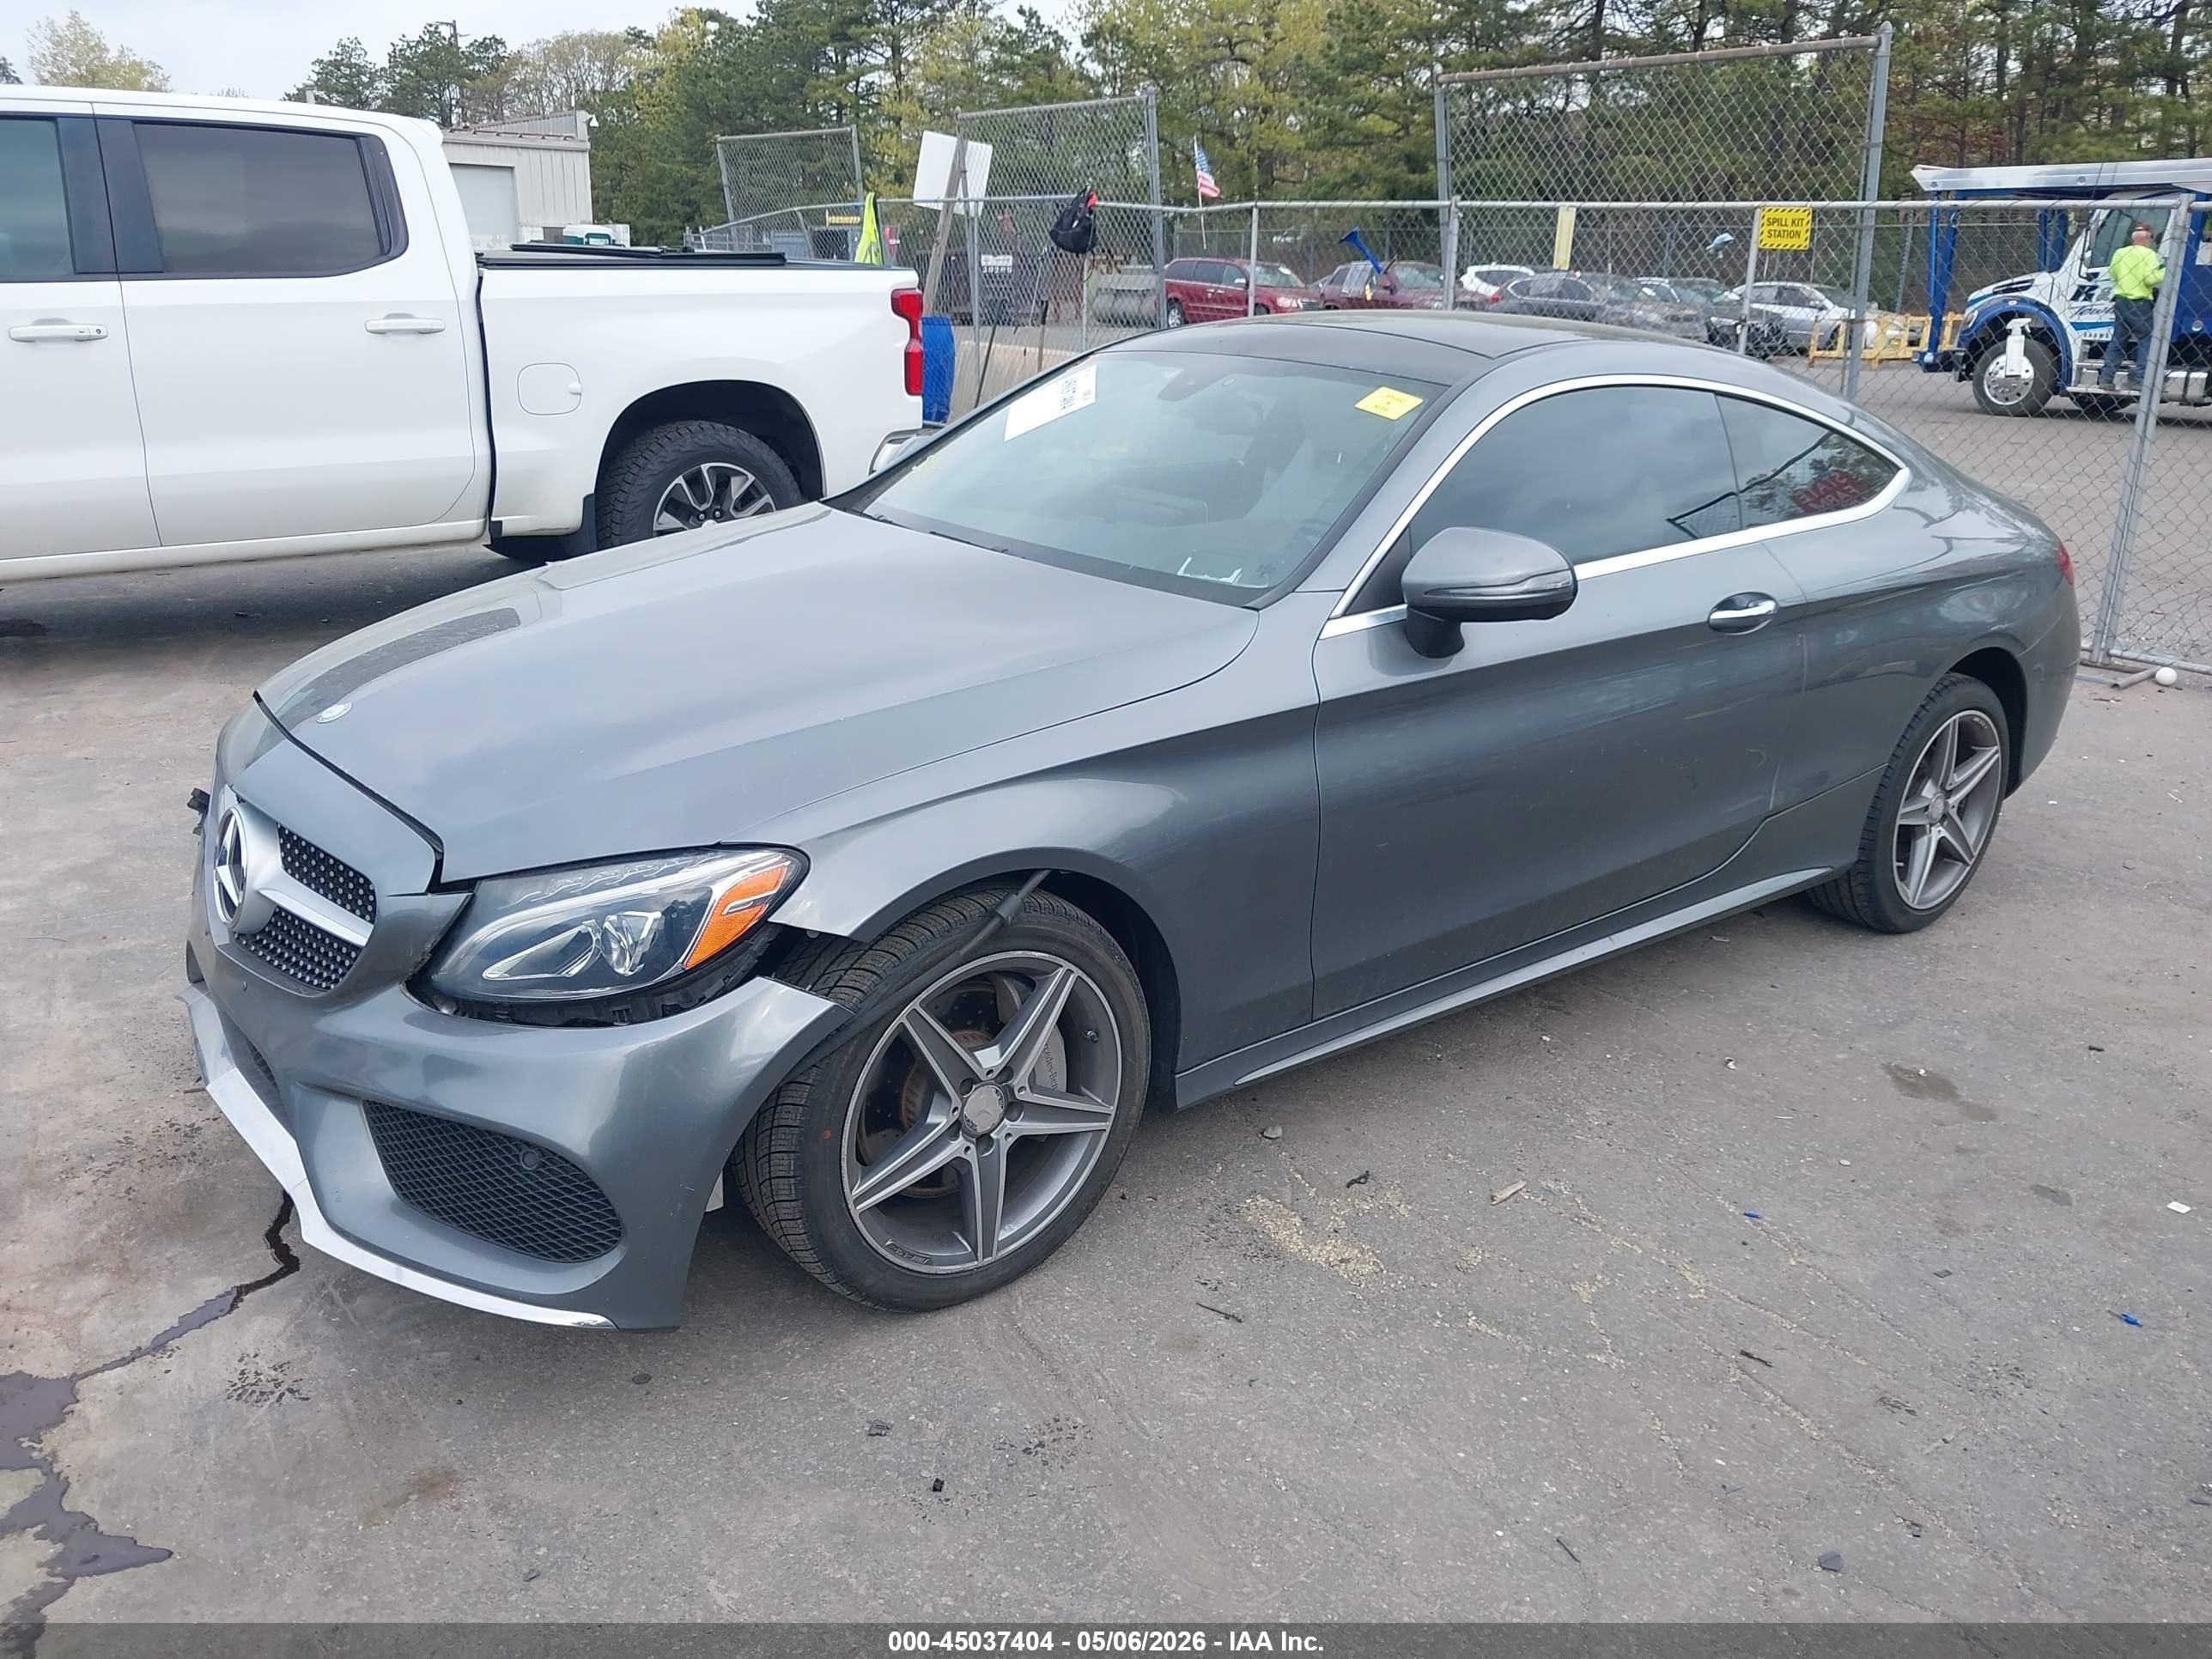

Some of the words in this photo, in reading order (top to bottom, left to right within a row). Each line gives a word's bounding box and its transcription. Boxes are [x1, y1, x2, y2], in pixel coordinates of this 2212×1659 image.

[1766, 217, 1789, 227] SPILL
[1791, 217, 1805, 227] KIT
[1767, 229, 1801, 240] STATION
